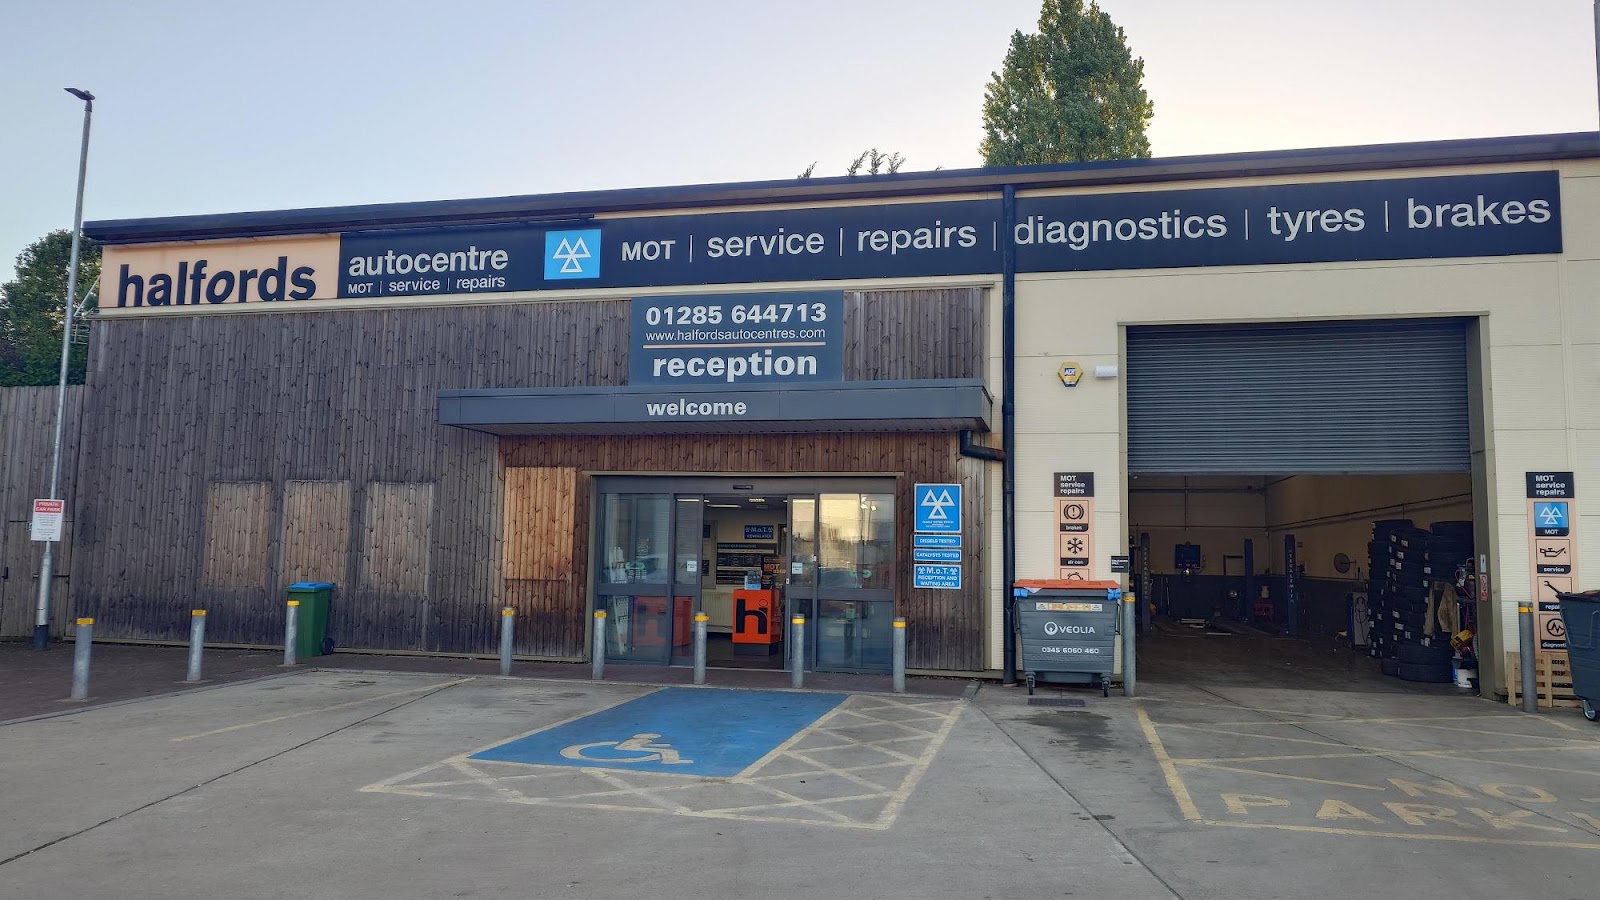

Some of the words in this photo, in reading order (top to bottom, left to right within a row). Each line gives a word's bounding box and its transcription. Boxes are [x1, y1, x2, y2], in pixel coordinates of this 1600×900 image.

[621, 240, 676, 261] MOT
[707, 227, 825, 258] service
[858, 220, 977, 255] repairs
[1014, 209, 1228, 251] diagnostics
[1266, 206, 1366, 242] tyres
[1407, 194, 1552, 229] brakes
[348, 245, 509, 277] autocentre
[117, 256, 317, 308] halfords
[347, 282, 374, 294] MOT
[388, 277, 441, 292] service
[456, 274, 506, 292] repairs
[645, 305, 723, 326] 01285
[730, 302, 827, 324] 644713
[645, 328, 826, 341] www.halfordsautocentres.com
[653, 349, 817, 383] reception
[646, 398, 747, 416] welcome
[1536, 488, 1566, 496] repairs
[1058, 626, 1096, 634] VEOLIA
[1386, 778, 1558, 803] NO
